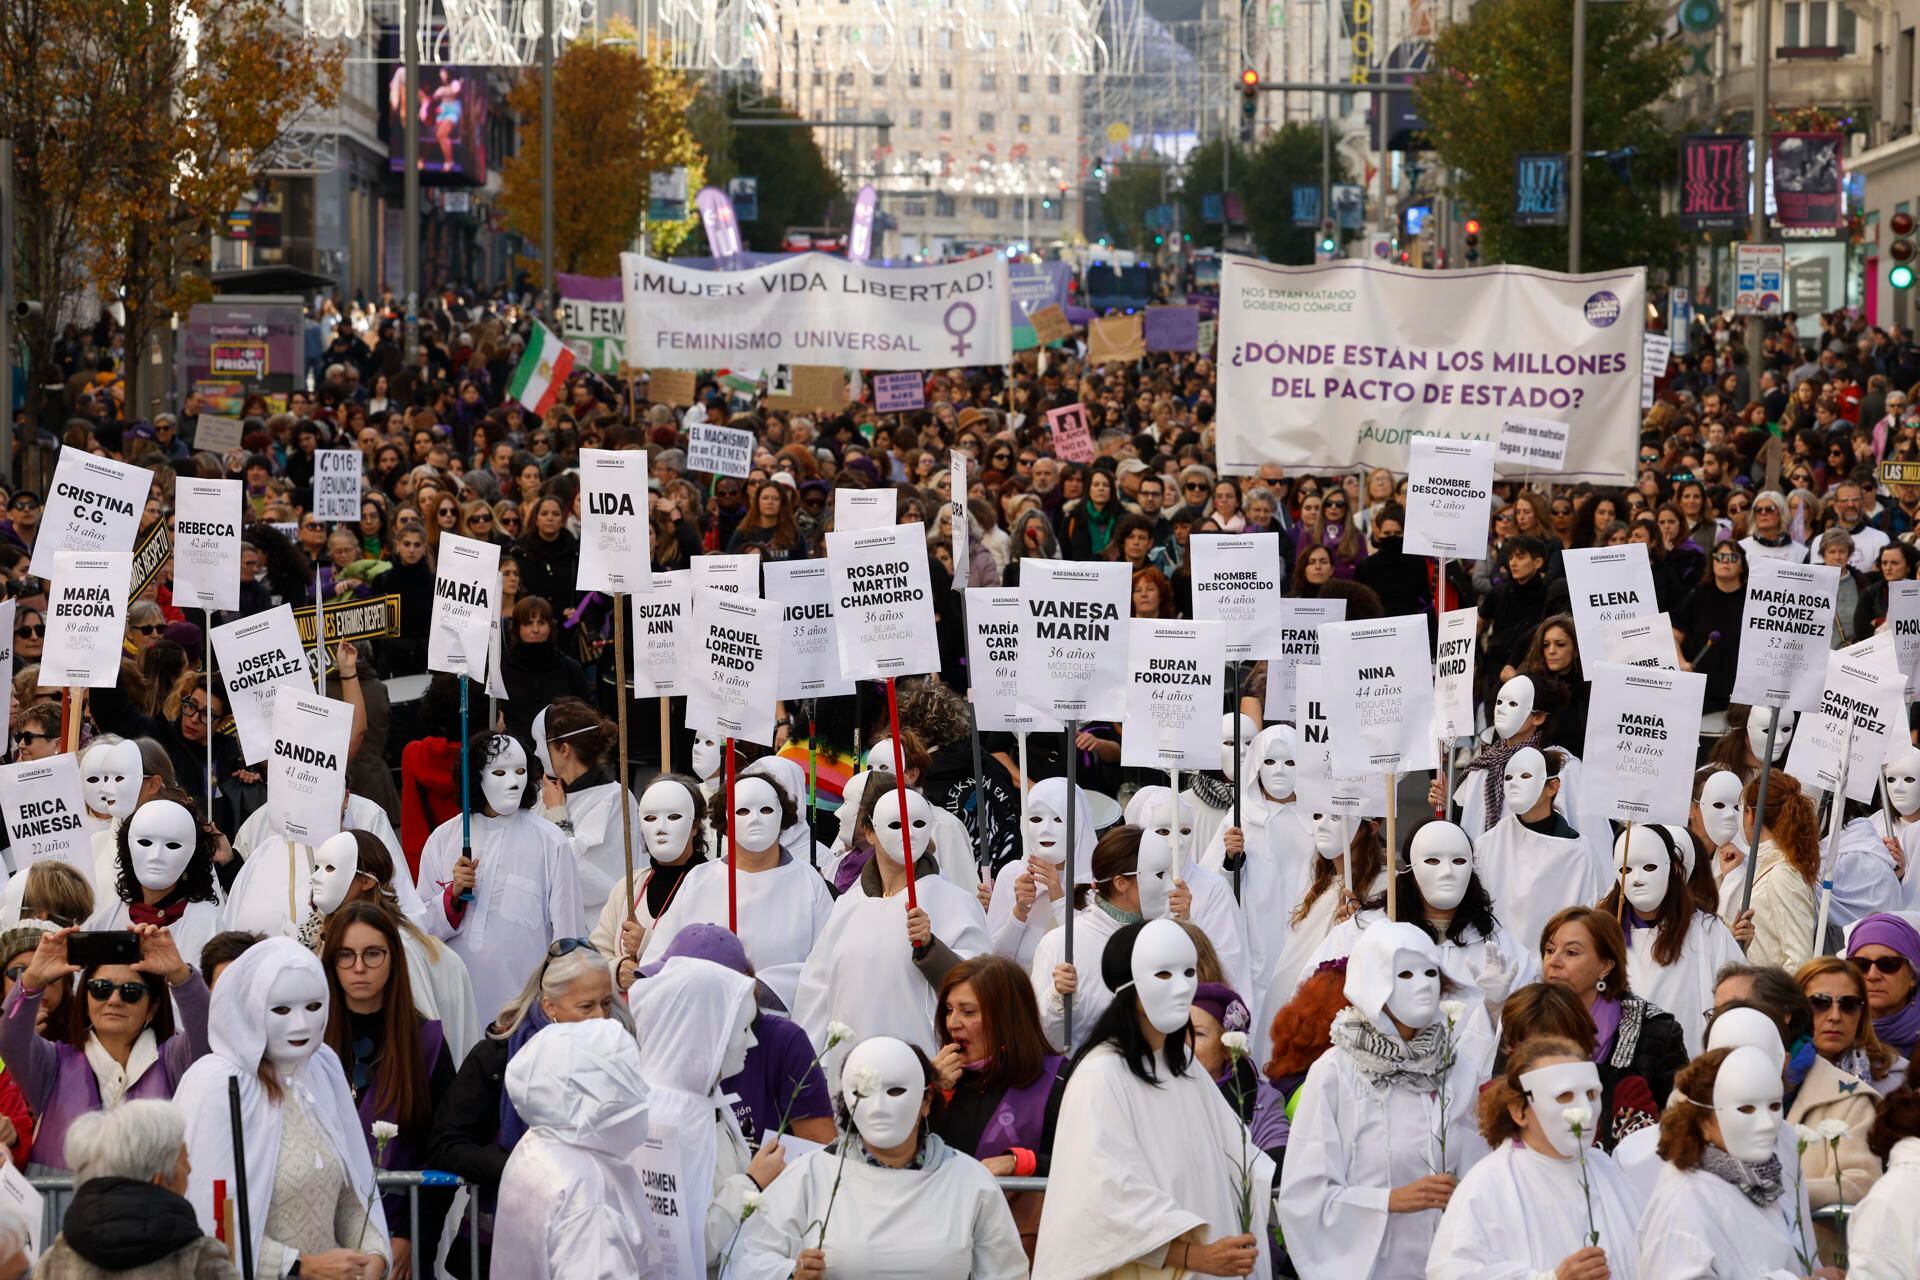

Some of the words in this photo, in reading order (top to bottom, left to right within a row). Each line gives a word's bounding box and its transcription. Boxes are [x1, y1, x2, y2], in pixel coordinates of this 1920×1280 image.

[633, 273, 745, 297] ¡MUJER
[760, 273, 828, 294] VIDA
[842, 270, 994, 301] LIBERTAD!
[1241, 288, 1265, 298] NOS
[1303, 289, 1357, 300] MATANDO
[1242, 300, 1300, 312] GOBIERNO
[564, 304, 584, 331] EL
[656, 331, 782, 351] FEMINISMO
[794, 331, 921, 352] UNIVERSAL
[1231, 339, 1336, 367] ¿DÓNDE
[1343, 345, 1427, 370] ESTÁN
[1437, 351, 1484, 371] LOS
[1493, 352, 1626, 375] MILLONES
[215, 359, 264, 380] FRIDAY
[1271, 377, 1316, 398] DEL
[1324, 377, 1415, 403] PACTO
[1423, 383, 1454, 404] DE
[1461, 384, 1584, 409] ESTADO?
[692, 427, 701, 440] EL
[710, 444, 747, 461] CRIMEN
[1500, 441, 1520, 455] togas
[1522, 446, 1528, 457] y
[84, 461, 111, 475] ASESINADA
[333, 453, 356, 471] 016:
[690, 456, 719, 470] CONTRA
[720, 460, 746, 475] TODOS
[1885, 464, 1902, 480] LAS
[1428, 476, 1471, 489] NOMBRE
[57, 482, 135, 517] CRISTINA
[1412, 484, 1486, 499] DESCONOCIDO
[589, 491, 635, 516] LIDA
[1429, 499, 1441, 509] 42
[1443, 500, 1466, 511] años
[73, 504, 108, 526] C.G.
[66, 522, 80, 536] 54
[81, 528, 106, 542] años
[178, 520, 235, 537] REBECCA
[608, 522, 626, 534] años
[190, 538, 199, 549] 42
[200, 538, 219, 549] años
[854, 537, 883, 546] ASESINADA
[847, 561, 910, 580] ROSARIO
[1214, 571, 1258, 581] NOMBRE
[852, 573, 908, 593] MARTÍN
[1198, 581, 1274, 592] DESCONOCIDO
[63, 585, 110, 601] MARÍA
[436, 577, 489, 608] MARÍA
[840, 588, 924, 609] CHAMORRO
[1217, 595, 1231, 605] 46
[1233, 594, 1256, 605] años
[1589, 590, 1640, 607] ELENA
[1750, 588, 1795, 605] MARÍA
[1798, 594, 1831, 610] ROSA
[56, 600, 115, 618] BEGOÑA
[451, 605, 472, 618] años
[640, 602, 681, 619] SUZAN
[719, 601, 744, 612] ASESINADA
[1028, 599, 1120, 621] VANESA
[1767, 603, 1814, 621] GÓMEZ
[864, 611, 877, 624] 36
[878, 610, 904, 622] años
[1600, 611, 1612, 621] 68
[1614, 610, 1636, 621] años
[65, 622, 77, 632] 89
[78, 622, 100, 633] años
[647, 620, 673, 635] ANN
[792, 625, 805, 637] 35
[807, 624, 828, 637] años
[978, 620, 1019, 635] MARÍA
[1036, 619, 1110, 642] MARÍN
[1351, 629, 1382, 637] ASESINADA
[1750, 616, 1826, 637] FERNÁNDEZ
[710, 624, 760, 647] RAQUEL
[791, 637, 830, 648] VILLAVERDE
[656, 639, 676, 649] años
[705, 637, 763, 661] LORENTE
[796, 645, 827, 655] (MADRID)
[1439, 638, 1472, 659] KIRSTY
[1768, 637, 1782, 649] 52
[1783, 639, 1805, 651] años
[1048, 646, 1063, 659] 36
[1066, 647, 1096, 660] años
[235, 648, 287, 675] JOSEFA
[710, 652, 755, 672] PARDO
[1150, 658, 1197, 671] BURAN
[1440, 658, 1466, 678] WARD
[1756, 658, 1770, 667] DEL
[229, 658, 303, 693] GONZÁLEZ
[711, 670, 725, 682] 58
[726, 673, 751, 689] años
[995, 667, 1008, 678] 60
[1051, 671, 1092, 681] (MADRID)
[1134, 672, 1212, 686] FOROUZAN
[1358, 666, 1396, 680] NINA
[1625, 676, 1658, 685] ASESINADA
[253, 690, 264, 703] 79
[1151, 689, 1165, 701] 64
[1167, 690, 1194, 702] años
[1355, 686, 1370, 698] 44
[1373, 684, 1402, 696] años
[710, 692, 749, 707] (VALENCIA)
[1355, 698, 1402, 710] ROQUETAS
[1823, 689, 1879, 719] CARMEN
[1149, 703, 1172, 712] JEREZ
[1172, 704, 1184, 712] DE
[1185, 704, 1197, 713] LA
[1151, 711, 1193, 721] FRONTERA
[1361, 710, 1379, 718] DEL
[1380, 708, 1400, 716] MAR
[1621, 713, 1665, 728] MARÍA
[1825, 721, 1838, 732] 43
[1617, 724, 1668, 740] TORRES
[274, 738, 338, 772] SANDRA
[1616, 740, 1632, 751] 48
[1634, 744, 1664, 758] años
[284, 766, 295, 778] 41
[296, 769, 319, 785] años
[288, 779, 313, 794] TOLEDO
[19, 797, 68, 820] ERICA
[11, 813, 83, 840] VANESSA
[32, 841, 43, 855] 22
[44, 838, 71, 853] años
[641, 1168, 677, 1193] CARMEN
